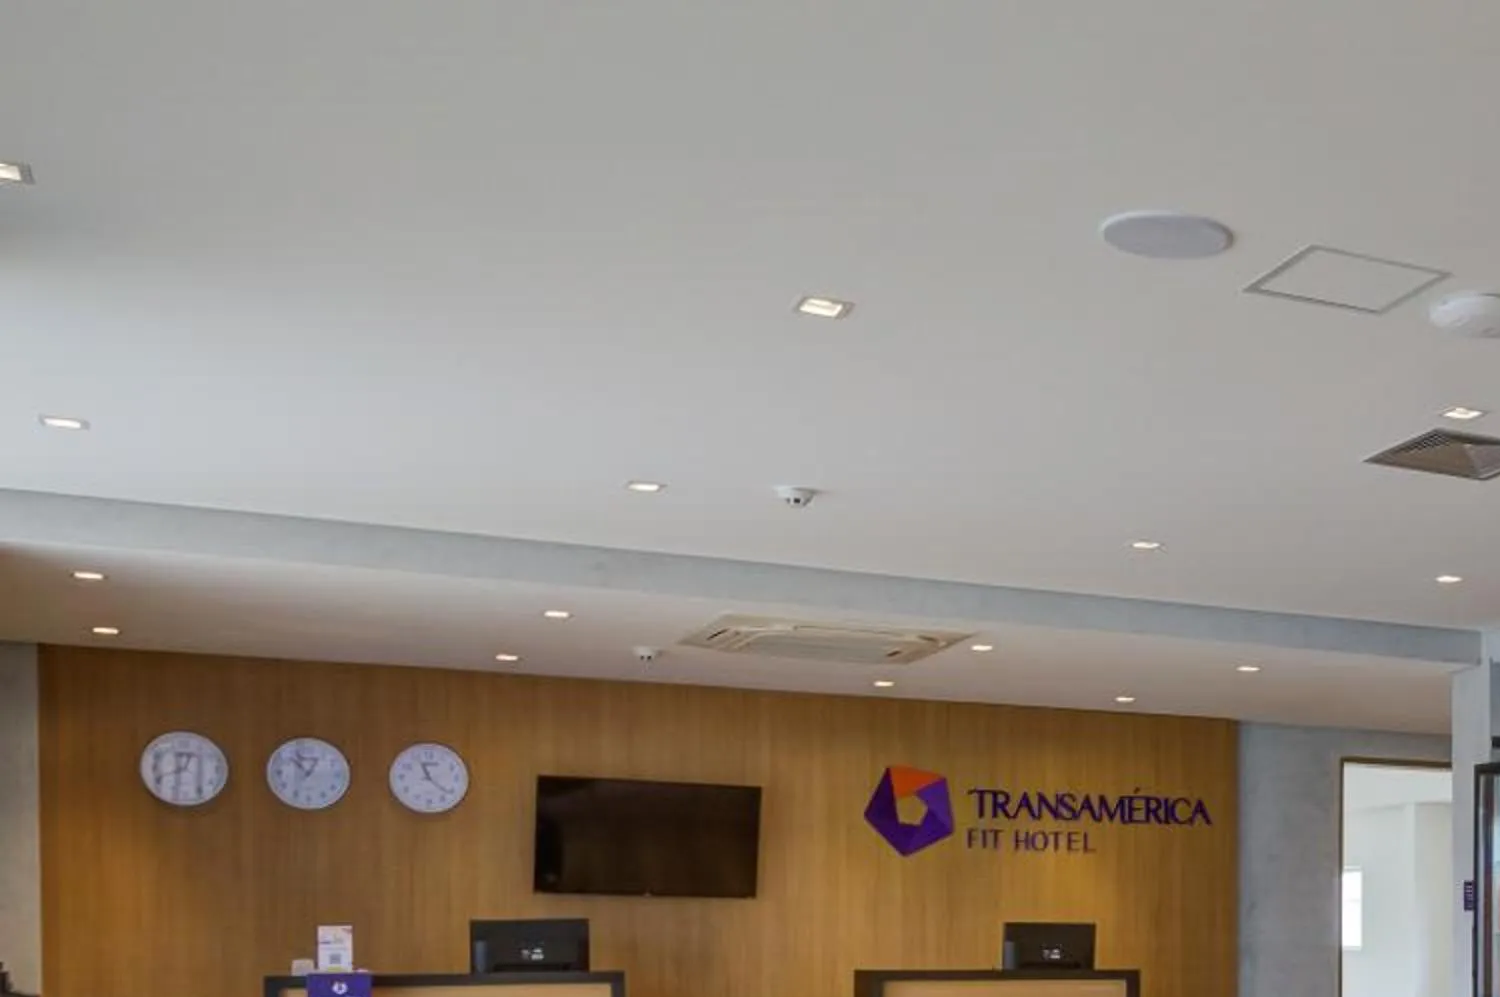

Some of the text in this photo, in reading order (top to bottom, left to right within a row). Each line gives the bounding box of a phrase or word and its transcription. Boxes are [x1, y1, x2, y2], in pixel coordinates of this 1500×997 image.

[967, 787, 1212, 826] TRANSAMÉRICA
[967, 828, 1096, 853] FIT HOTEL
